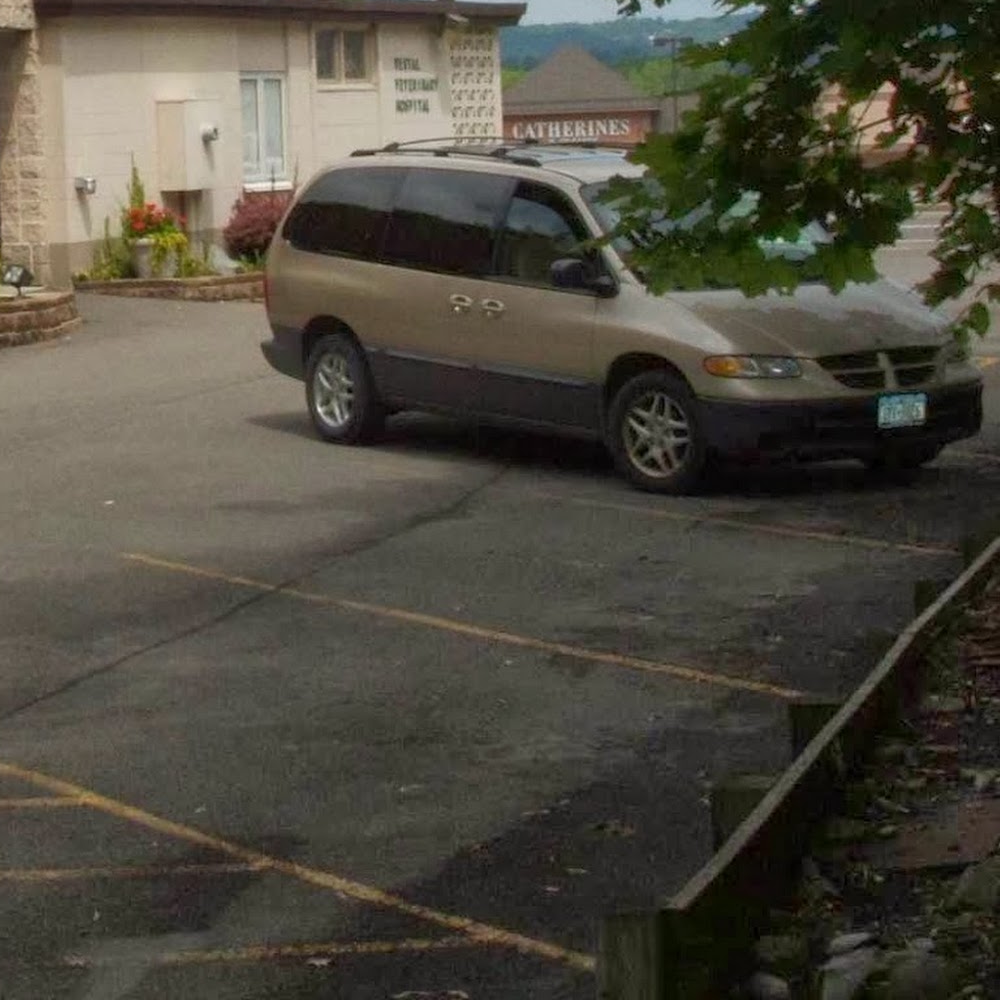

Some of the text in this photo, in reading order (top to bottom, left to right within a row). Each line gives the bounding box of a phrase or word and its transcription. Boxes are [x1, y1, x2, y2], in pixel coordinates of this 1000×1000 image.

[394, 78, 438, 92] VETERINARY
[395, 99, 429, 113] HOSPITAL
[512, 118, 629, 139] CATHERINES
